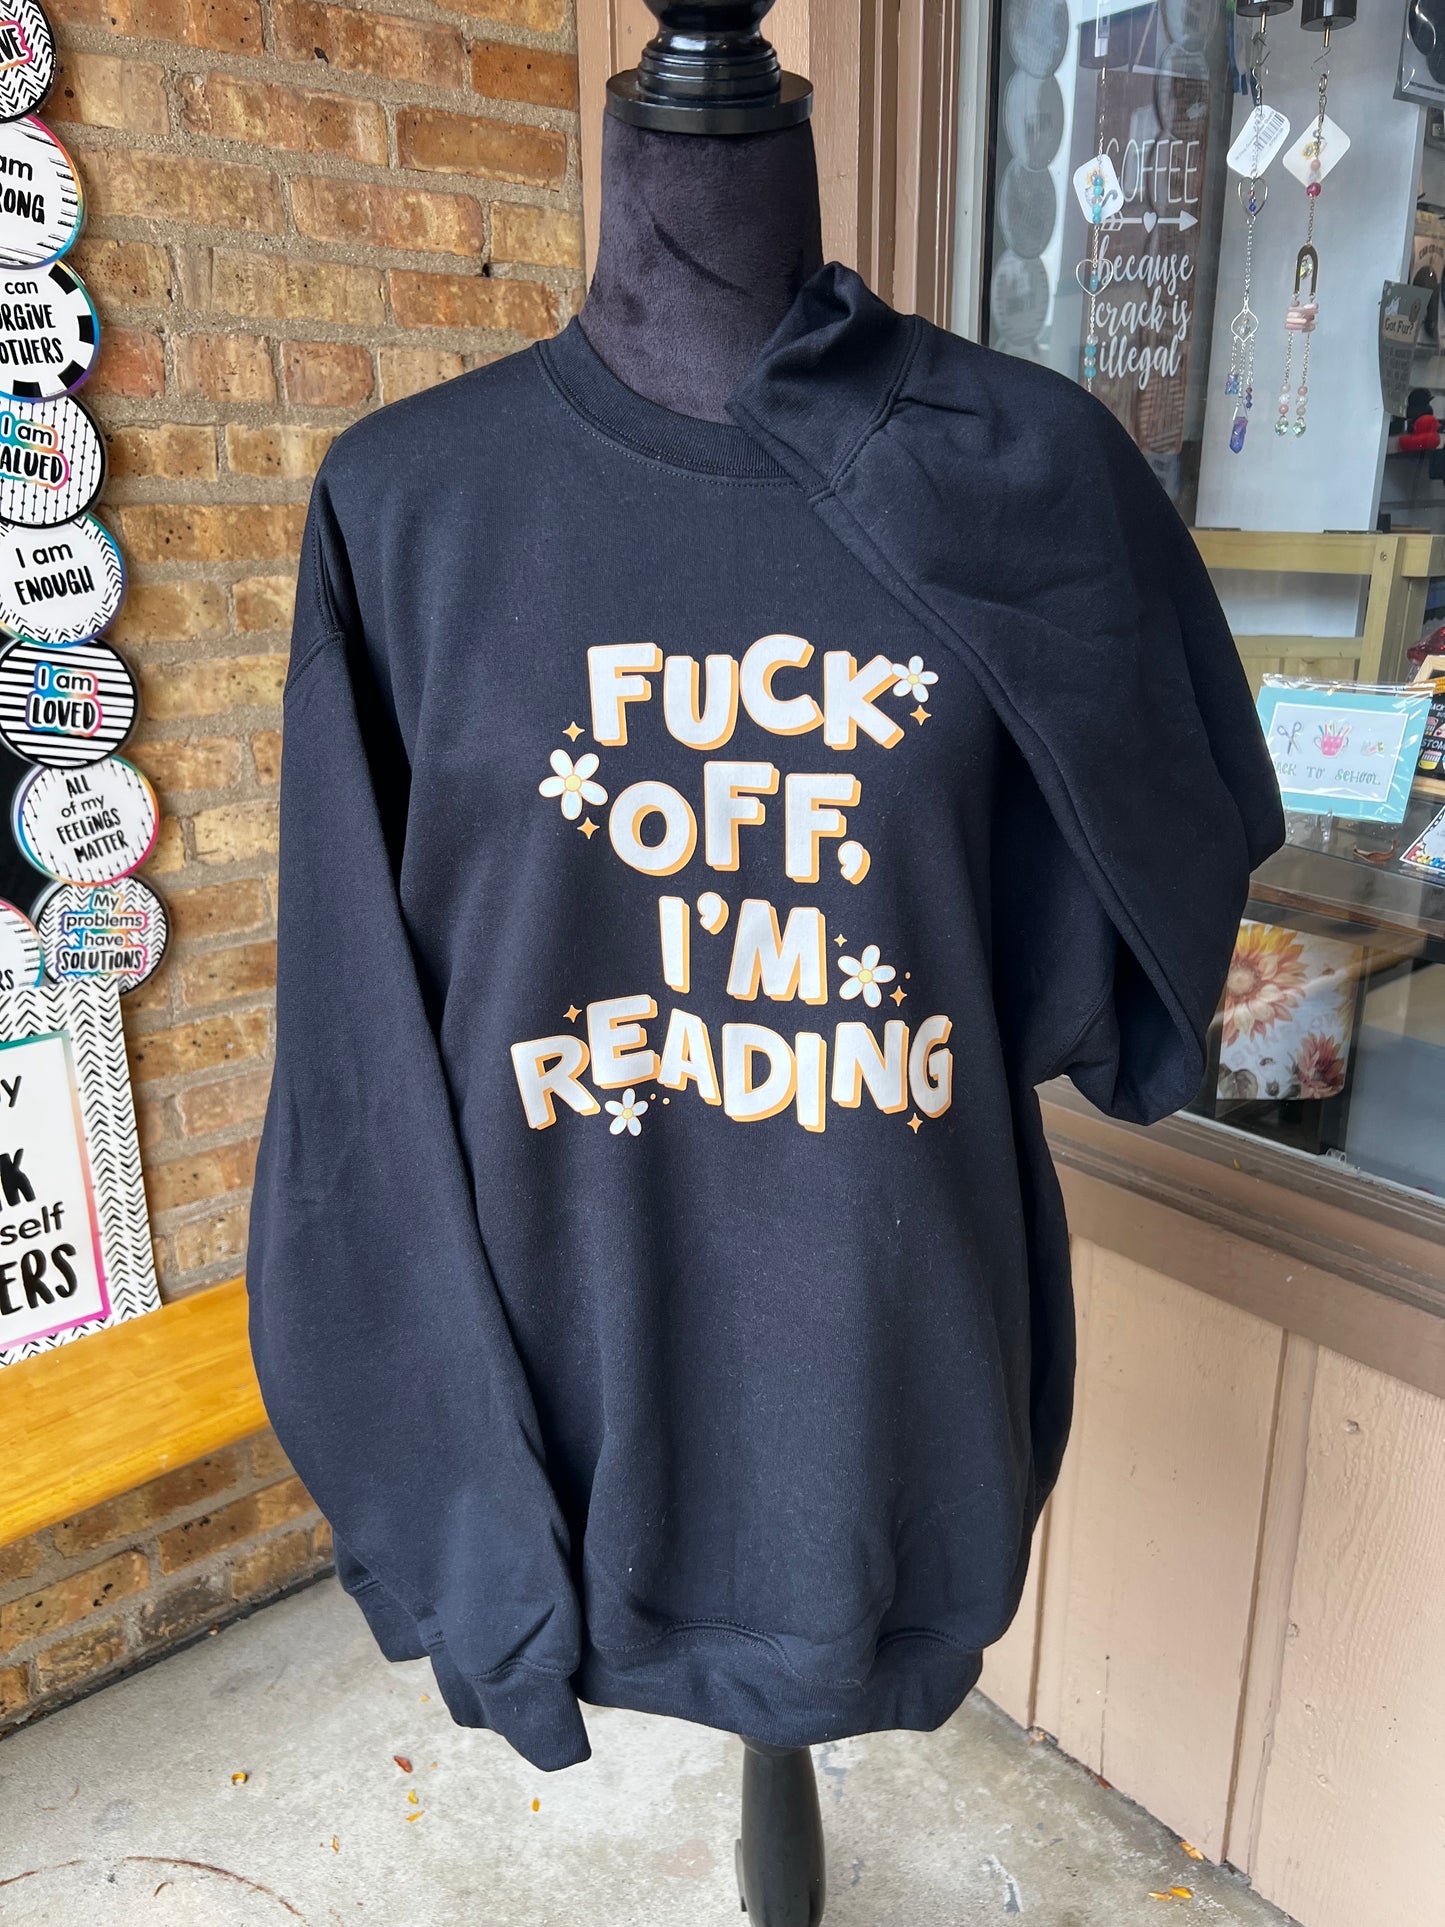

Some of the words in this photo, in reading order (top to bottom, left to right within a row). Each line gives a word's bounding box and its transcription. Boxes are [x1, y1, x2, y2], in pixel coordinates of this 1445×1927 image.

[1097, 234, 1194, 296] because
[4, 281, 39, 295] can
[1095, 285, 1167, 337] crack
[1171, 294, 1192, 341] is
[0, 336, 64, 366] OTHERS
[1100, 334, 1182, 391] illegal
[3, 416, 9, 435] I
[17, 425, 53, 446] am
[15, 547, 26, 568] I
[32, 543, 74, 566] am
[14, 565, 96, 606] ENOUGH
[40, 668, 46, 687] I
[56, 674, 92, 691] am
[587, 634, 905, 751] FUCK
[32, 697, 96, 730] LOVED
[65, 774, 92, 799] ALL
[1306, 765, 1325, 780] TO
[1335, 768, 1381, 786] SCHOOL
[61, 801, 77, 818] of
[81, 795, 105, 812] my
[609, 760, 871, 885] OFF,
[73, 829, 130, 863] MATTER
[93, 894, 120, 910] My
[66, 913, 143, 930] problems
[84, 932, 125, 946] have
[658, 892, 828, 1005] I'M
[510, 994, 953, 1133] READING
[0, 1201, 65, 1246] self
